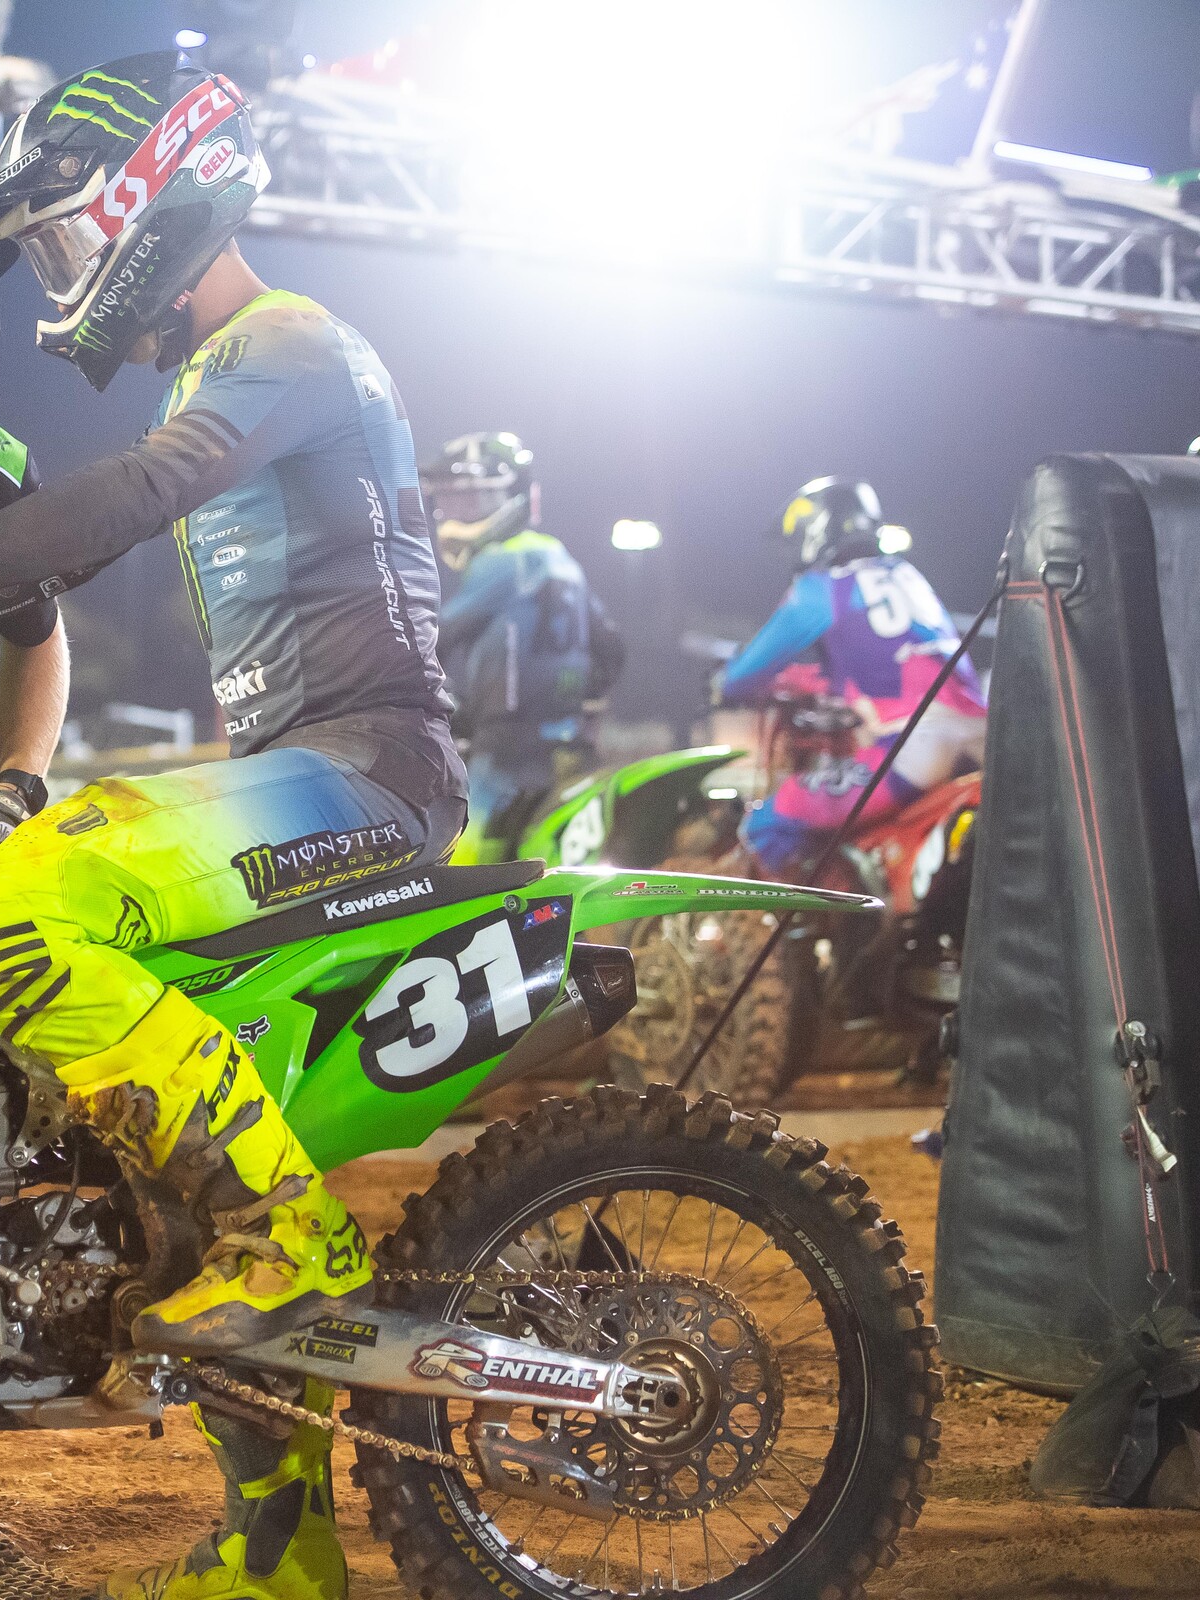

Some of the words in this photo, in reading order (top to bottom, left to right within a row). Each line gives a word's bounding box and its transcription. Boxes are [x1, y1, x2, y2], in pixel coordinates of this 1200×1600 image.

[200, 144, 233, 181] BELL
[91, 232, 161, 322] MONSTER
[117, 253, 161, 317] ENERGY
[204, 525, 241, 541] SCOTT
[217, 549, 240, 563] BELL
[357, 476, 385, 537] PRO
[373, 541, 410, 650] CIRCUIT
[0, 597, 36, 615] BRAKING
[211, 660, 267, 706] saki
[276, 823, 402, 870] MONSTER
[301, 851, 389, 878] ENERGY
[266, 880, 320, 903] PRO
[323, 850, 419, 888] CIRCUIT
[323, 878, 434, 920] Kawasaki
[523, 901, 566, 931] AMA
[364, 919, 532, 1077] 31
[206, 1040, 240, 1123] FOX
[794, 1230, 828, 1267] EXCEL
[824, 1266, 844, 1290] A60
[317, 1320, 376, 1337] EXCEL
[456, 1501, 477, 1527] A60
[428, 1482, 524, 1600] DUNLOP
[473, 1523, 508, 1561] EXCEL
